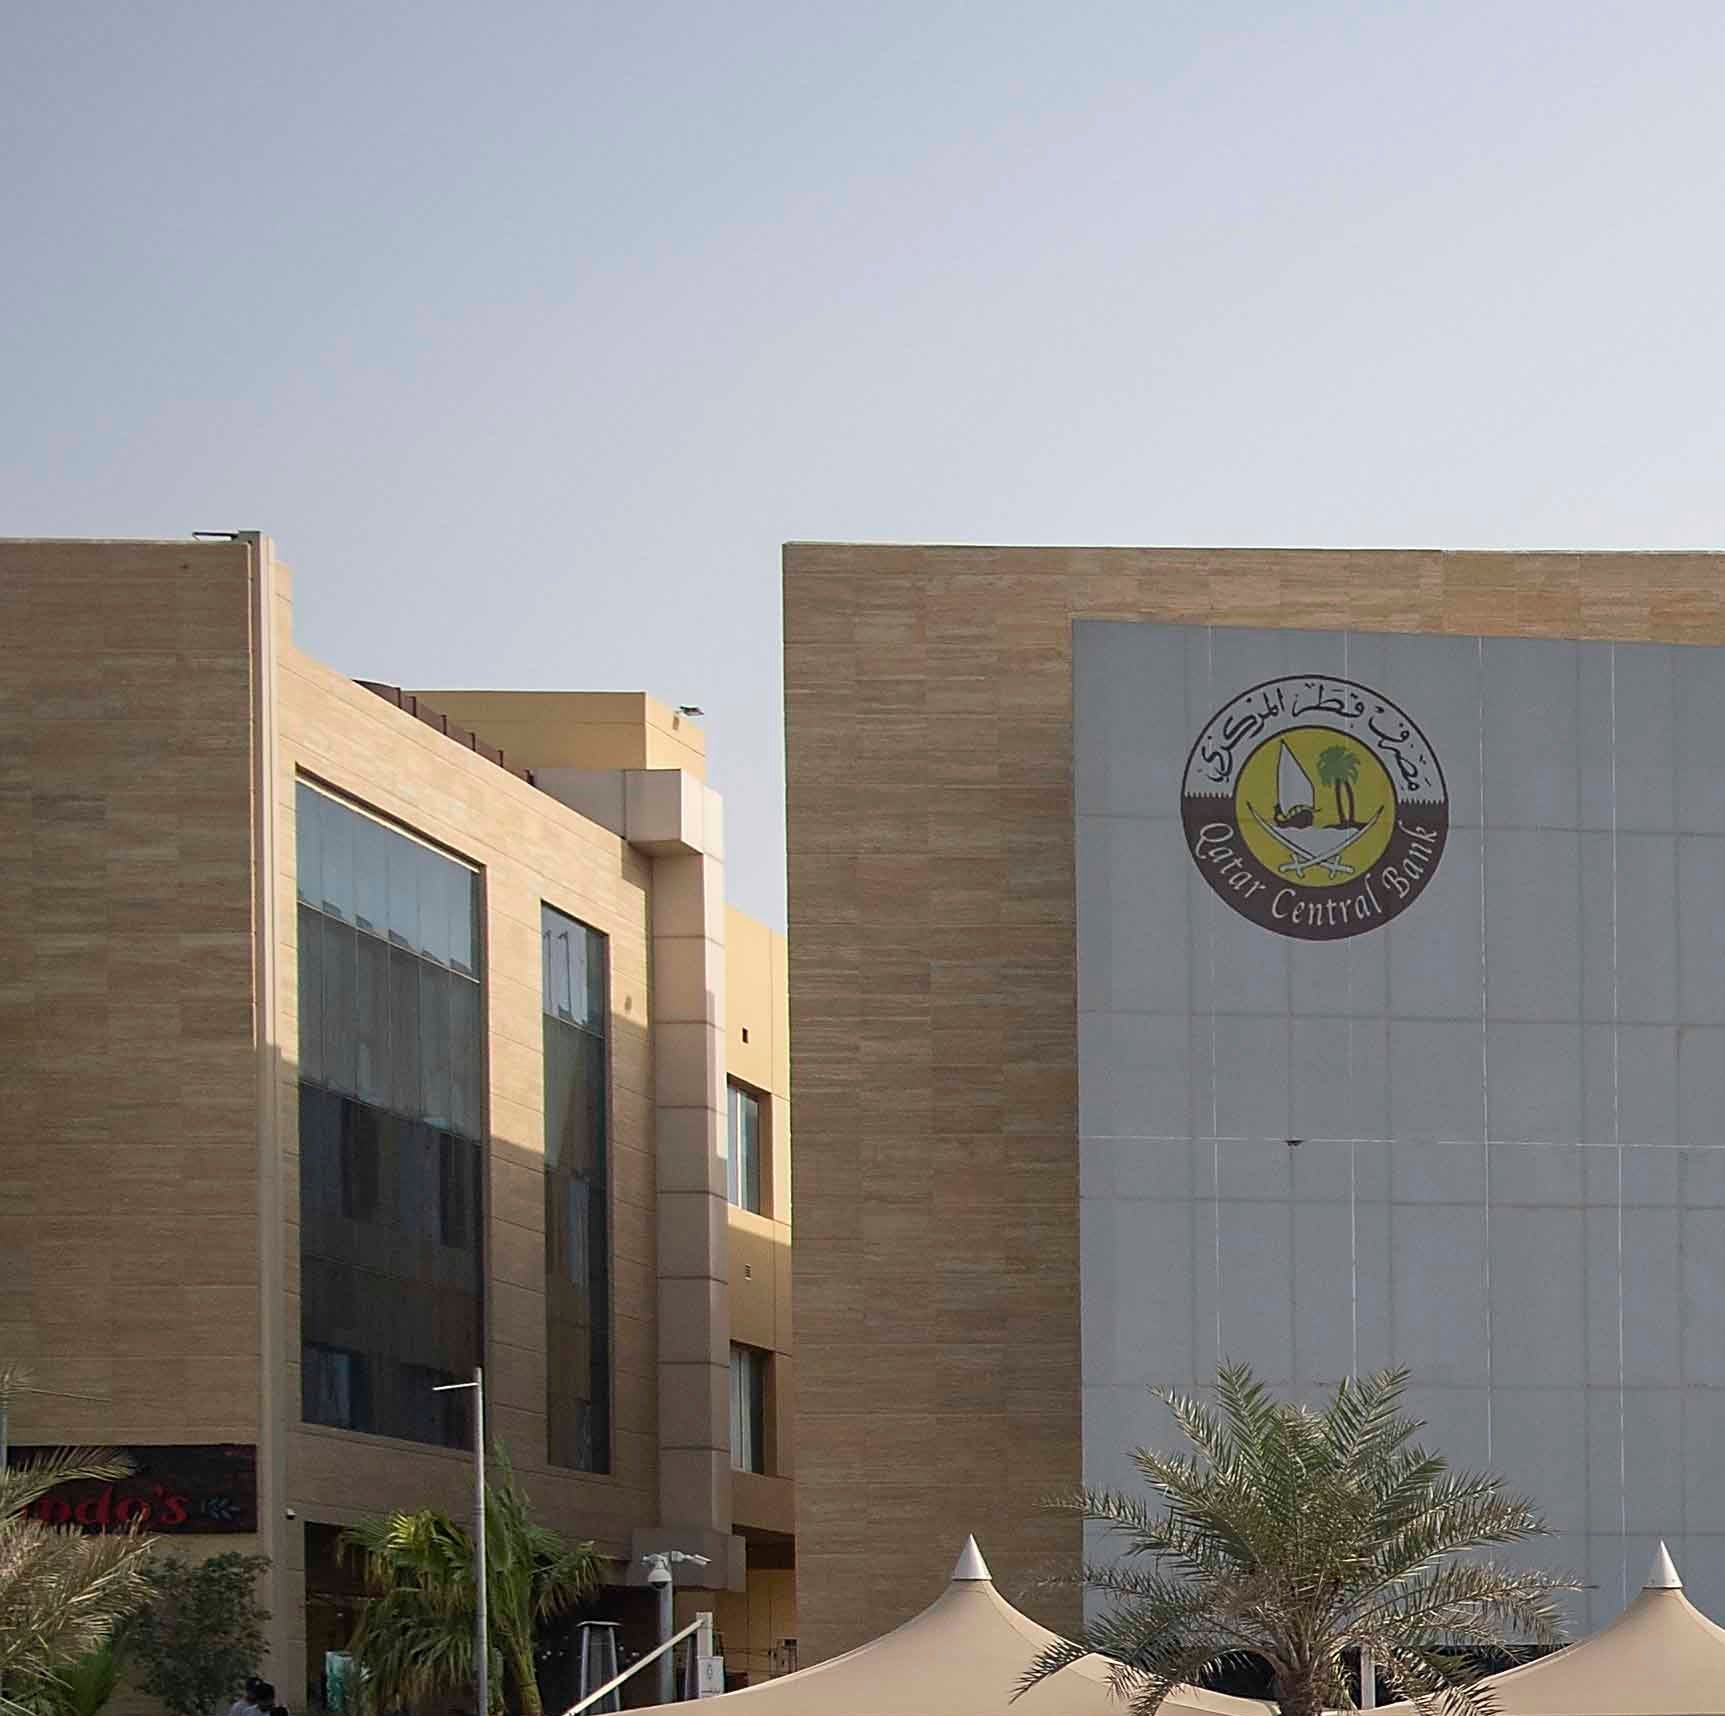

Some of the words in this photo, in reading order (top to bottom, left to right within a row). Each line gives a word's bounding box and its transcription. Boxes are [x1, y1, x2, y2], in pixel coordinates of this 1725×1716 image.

[1195, 822, 1266, 899] Qatar
[1272, 873, 1383, 927] Central
[1383, 820, 1438, 899] Bank
